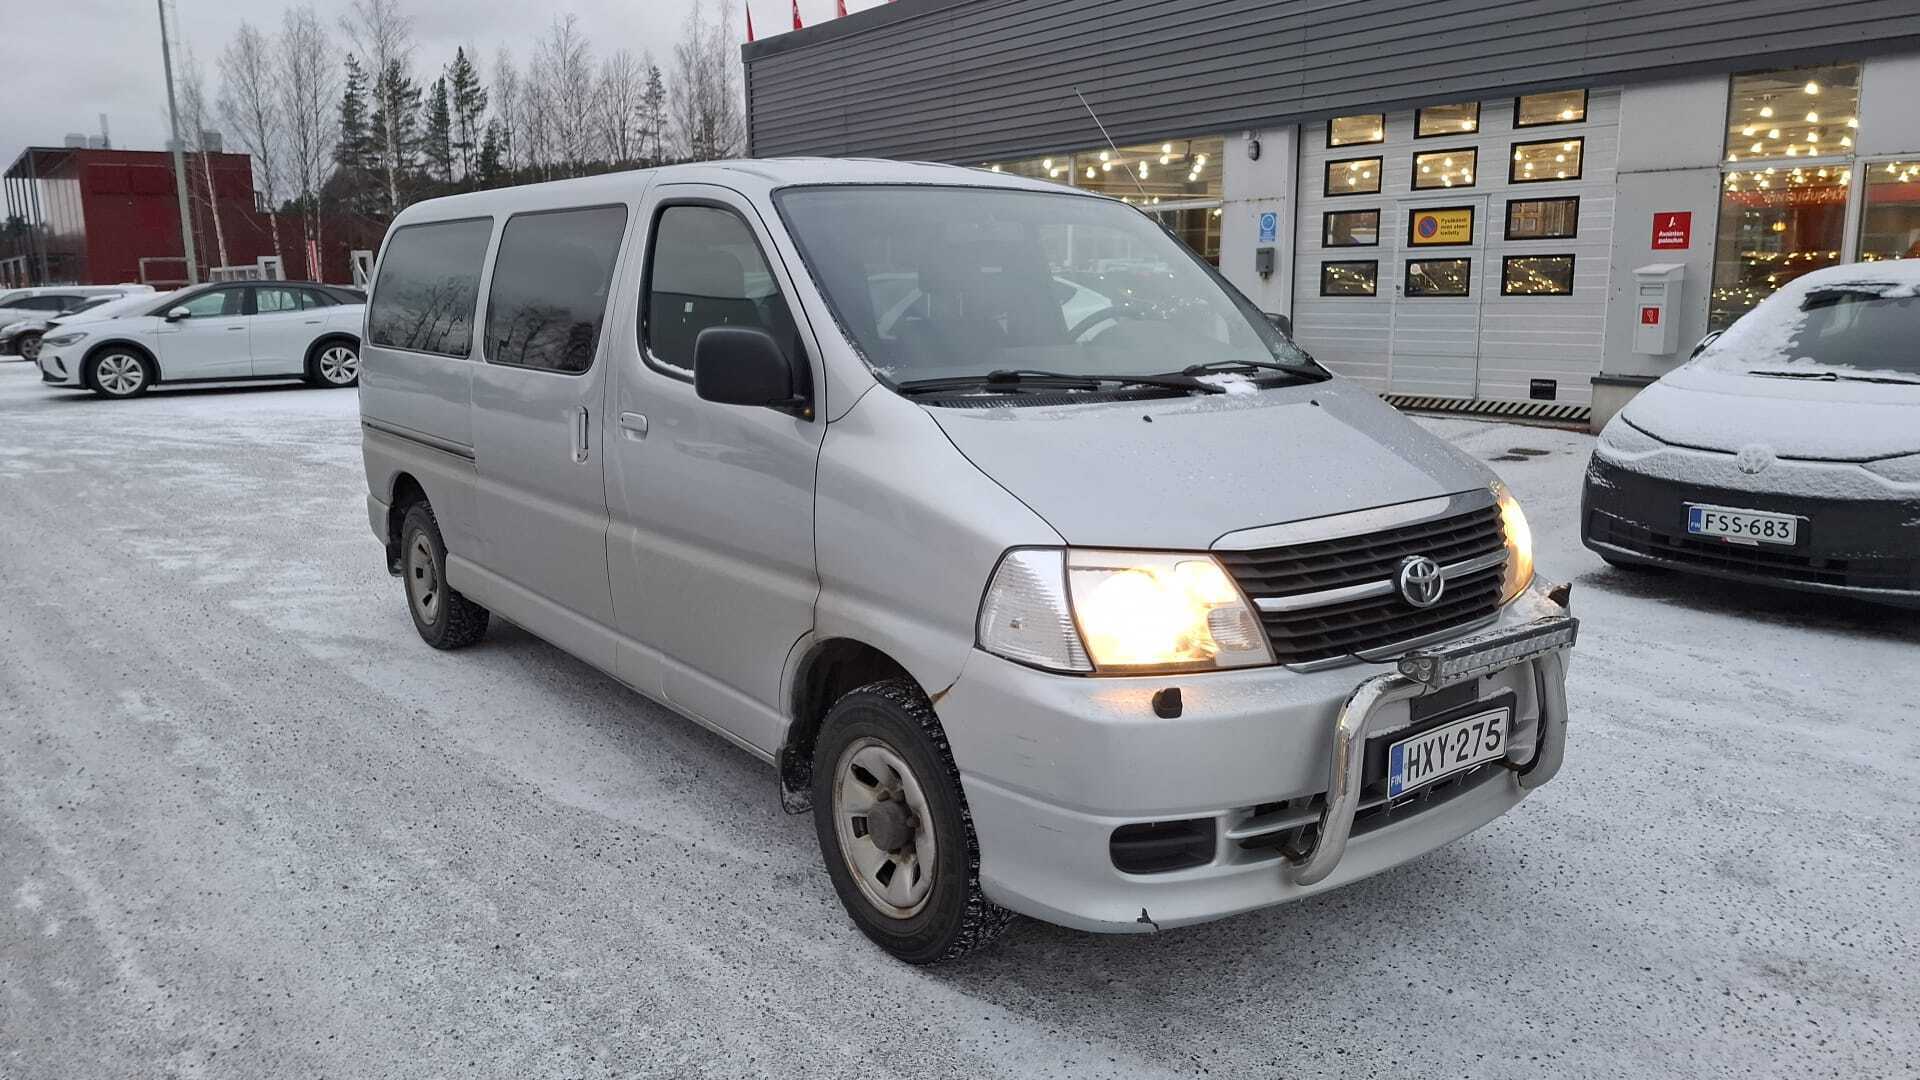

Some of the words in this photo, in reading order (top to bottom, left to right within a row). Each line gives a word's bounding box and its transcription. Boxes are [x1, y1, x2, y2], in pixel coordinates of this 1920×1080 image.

[1705, 513, 1790, 539] FSS-683
[1390, 773, 1403, 787] FIN
[1407, 718, 1501, 782] HXY-275
